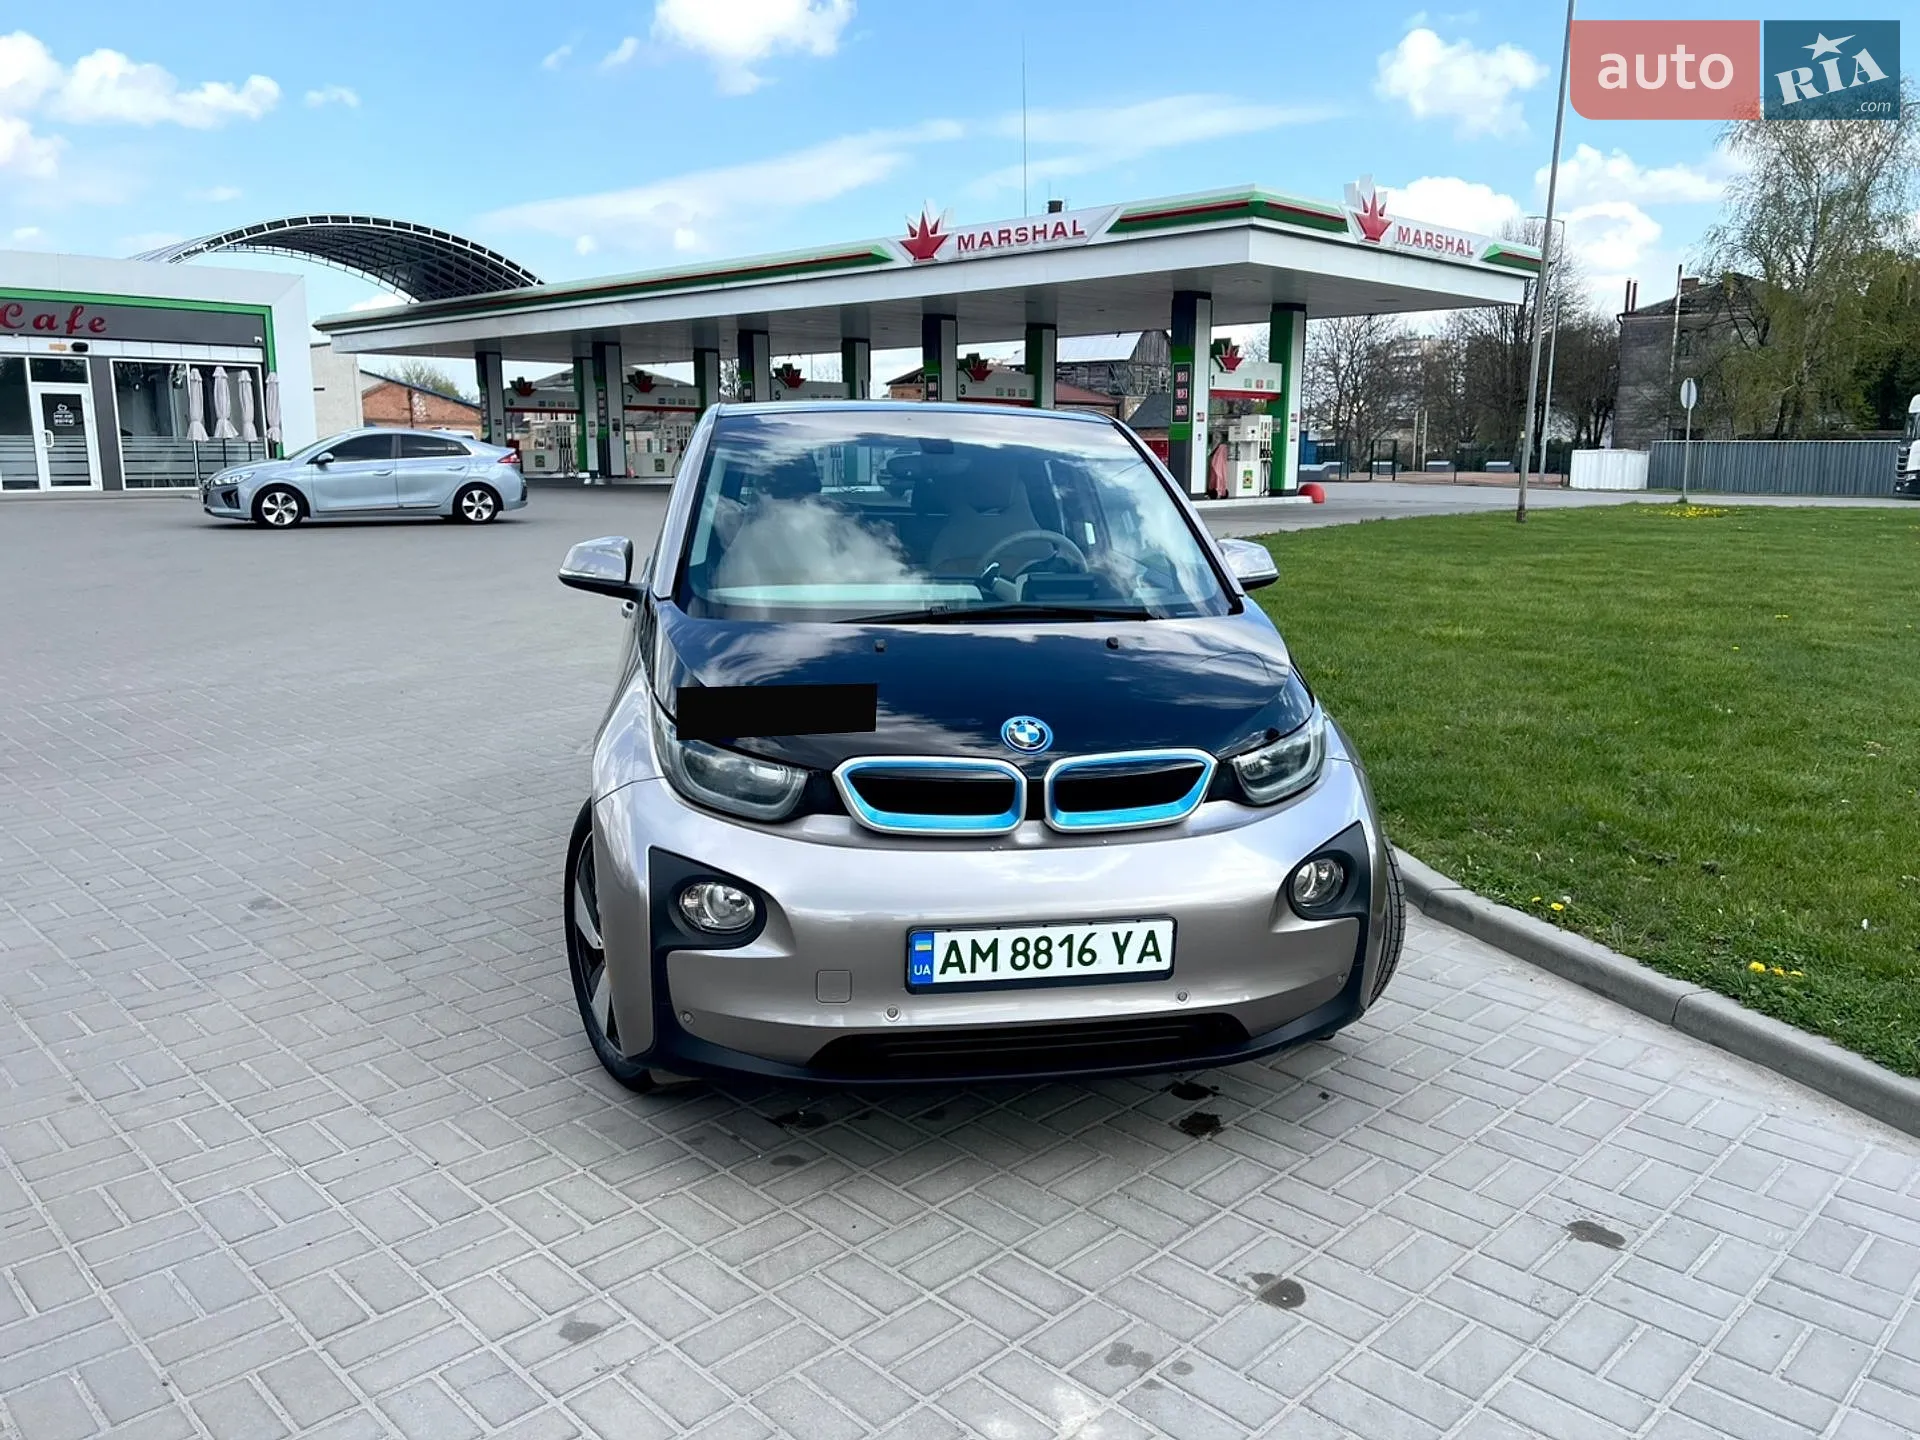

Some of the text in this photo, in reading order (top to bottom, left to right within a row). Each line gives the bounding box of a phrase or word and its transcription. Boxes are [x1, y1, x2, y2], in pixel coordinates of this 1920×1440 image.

[957, 219, 1085, 252] MARSHAL
[1397, 225, 1474, 256] MARSHAL
[0, 303, 107, 335] Cafe
[626, 394, 634, 403] 7
[959, 384, 967, 395] 3
[939, 929, 1162, 975] AM 8816 YA
[914, 965, 931, 975] UA
